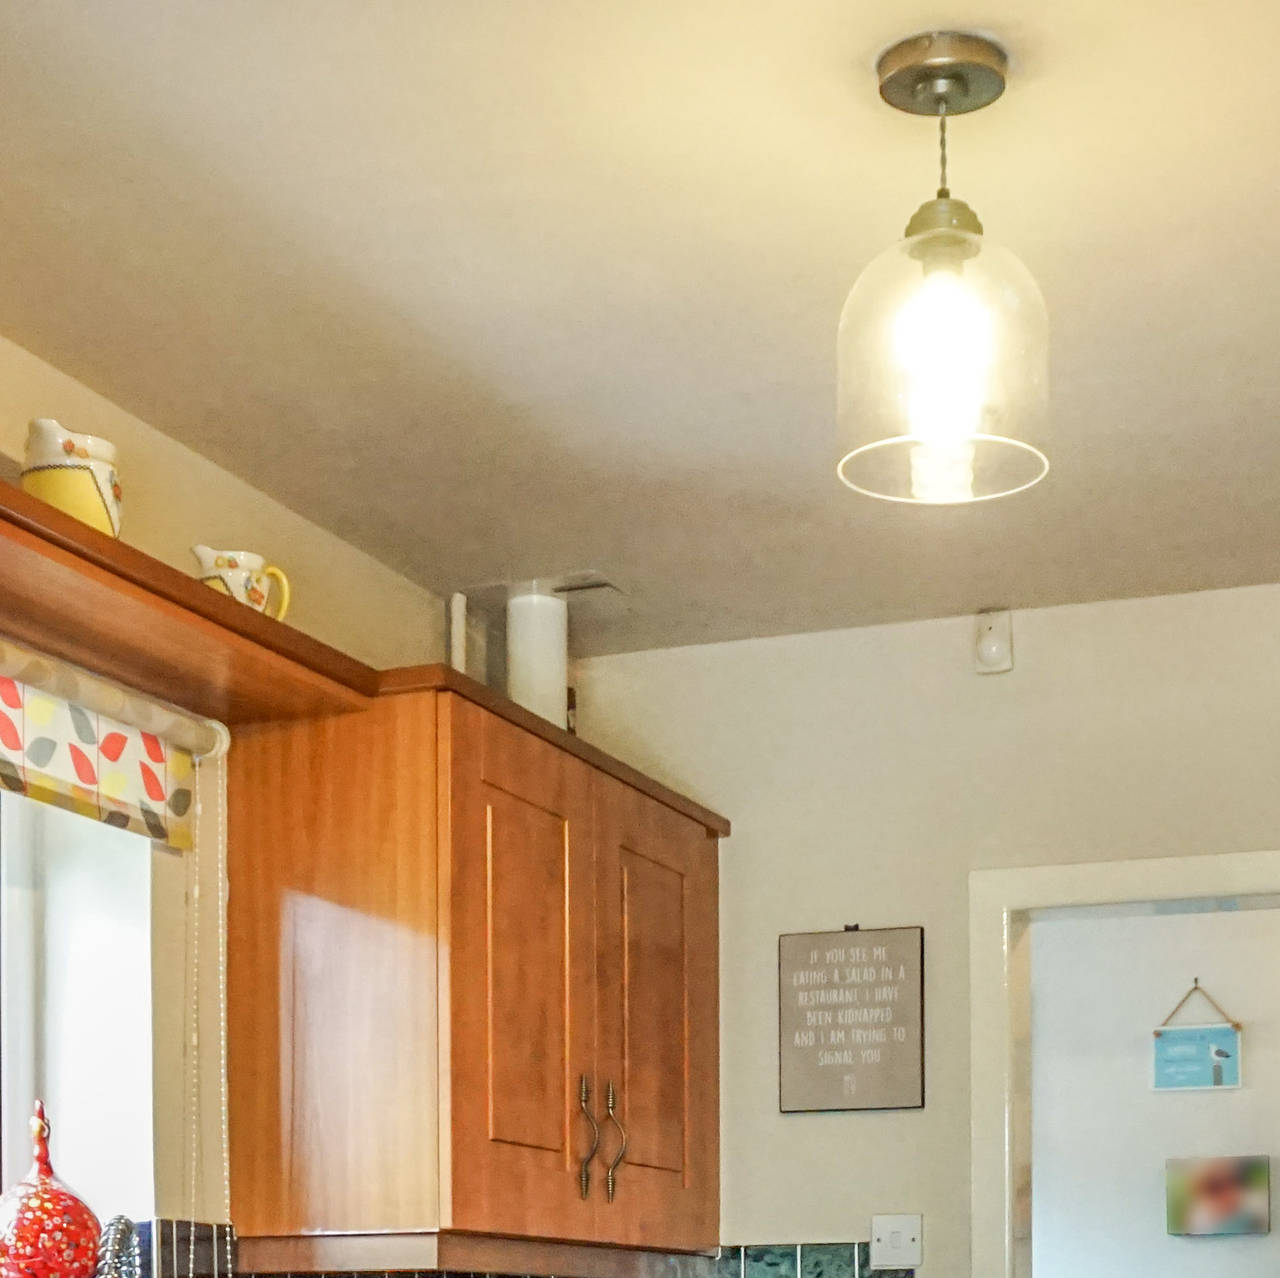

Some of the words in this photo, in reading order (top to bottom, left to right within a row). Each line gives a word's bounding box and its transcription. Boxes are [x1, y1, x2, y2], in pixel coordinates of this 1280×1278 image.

[825, 948, 845, 964] YOU
[849, 947, 867, 963] SEE
[873, 946, 887, 961] ME
[792, 970, 828, 986] EATING
[833, 968, 840, 984] A
[845, 966, 876, 983] SALAD
[881, 965, 893, 981] IN
[898, 964, 905, 980] A
[875, 985, 899, 1001] HAVE
[806, 1010, 832, 1025] BEEN
[838, 1007, 893, 1025] KIDNAPPED
[793, 1030, 815, 1047] AND
[830, 1028, 845, 1045] AM
[851, 1027, 887, 1044] TRYING
[893, 1026, 906, 1042] TO
[818, 1049, 855, 1066] SIGNAL
[861, 1048, 881, 1064] YOU
